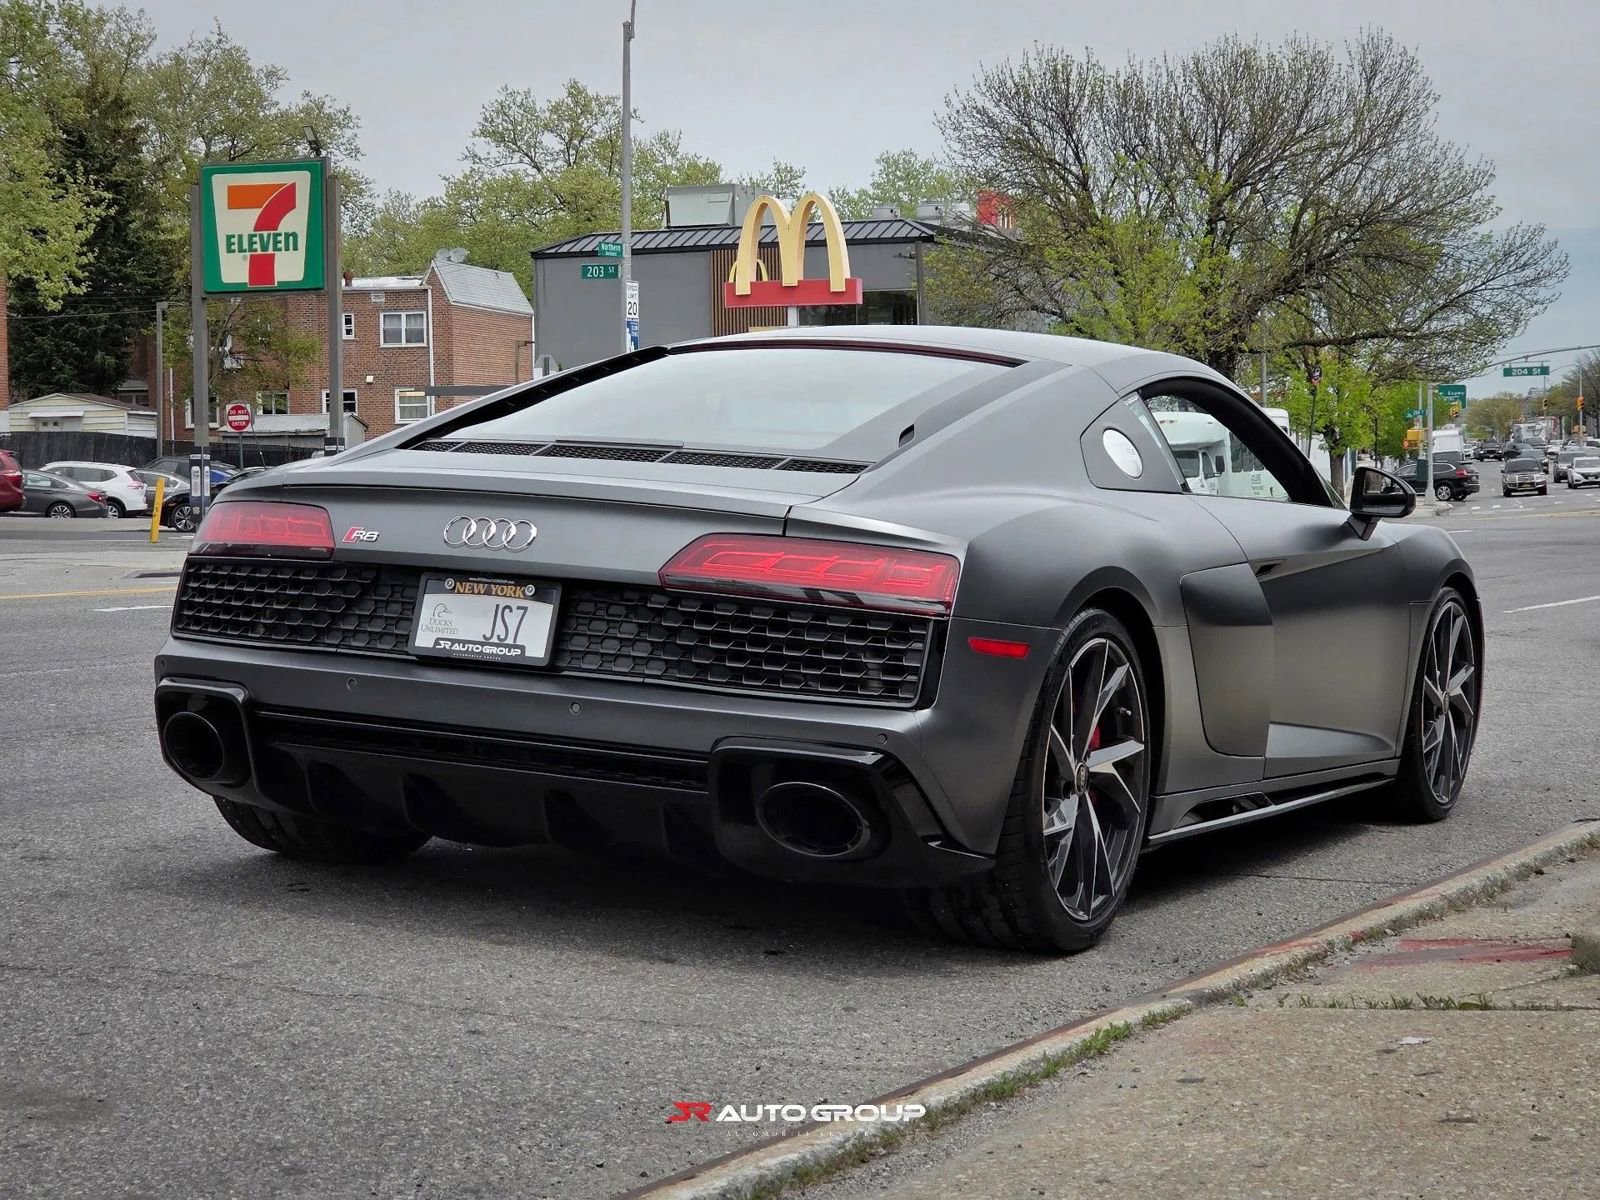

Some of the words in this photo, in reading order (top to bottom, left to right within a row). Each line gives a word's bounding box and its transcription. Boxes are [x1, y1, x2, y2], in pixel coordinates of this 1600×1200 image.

[227, 182, 297, 286] 7
[587, 266, 604, 278] 203
[627, 301, 638, 316] 20
[1511, 368, 1528, 376] 204
[349, 529, 380, 543] R8
[454, 581, 487, 595] NEW
[490, 584, 526, 599] YORK
[429, 617, 453, 627] DUCKS
[482, 603, 529, 644] JS7
[421, 624, 459, 635] UNLIMITED
[451, 642, 482, 653] AUTO
[482, 645, 522, 657] GROUP
